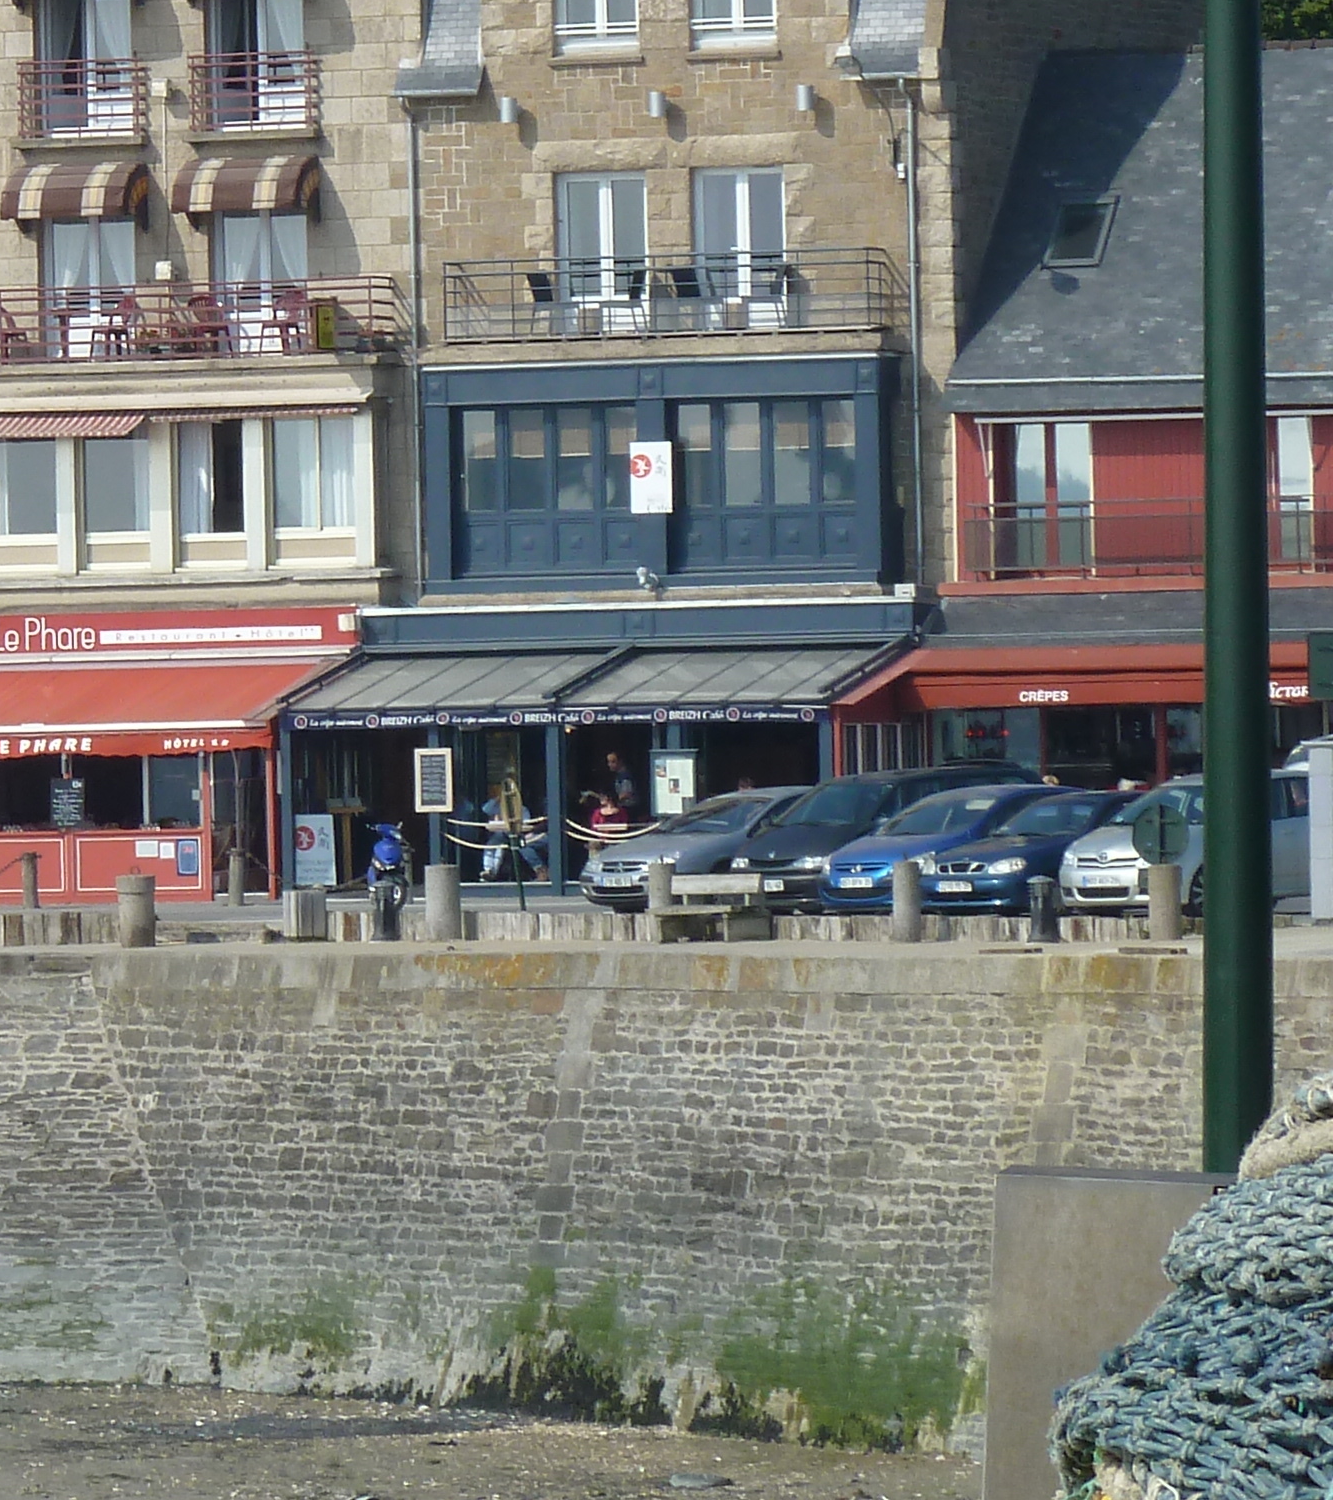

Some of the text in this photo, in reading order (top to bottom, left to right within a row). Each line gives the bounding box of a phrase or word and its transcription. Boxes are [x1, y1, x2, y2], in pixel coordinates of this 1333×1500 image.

[24, 617, 96, 651] Phare
[114, 630, 227, 643] Restaurant
[1019, 688, 1069, 702] CRÊPES
[524, 713, 556, 722] BREIZH
[668, 710, 701, 720] BREIZH
[19, 737, 92, 754] PHARE
